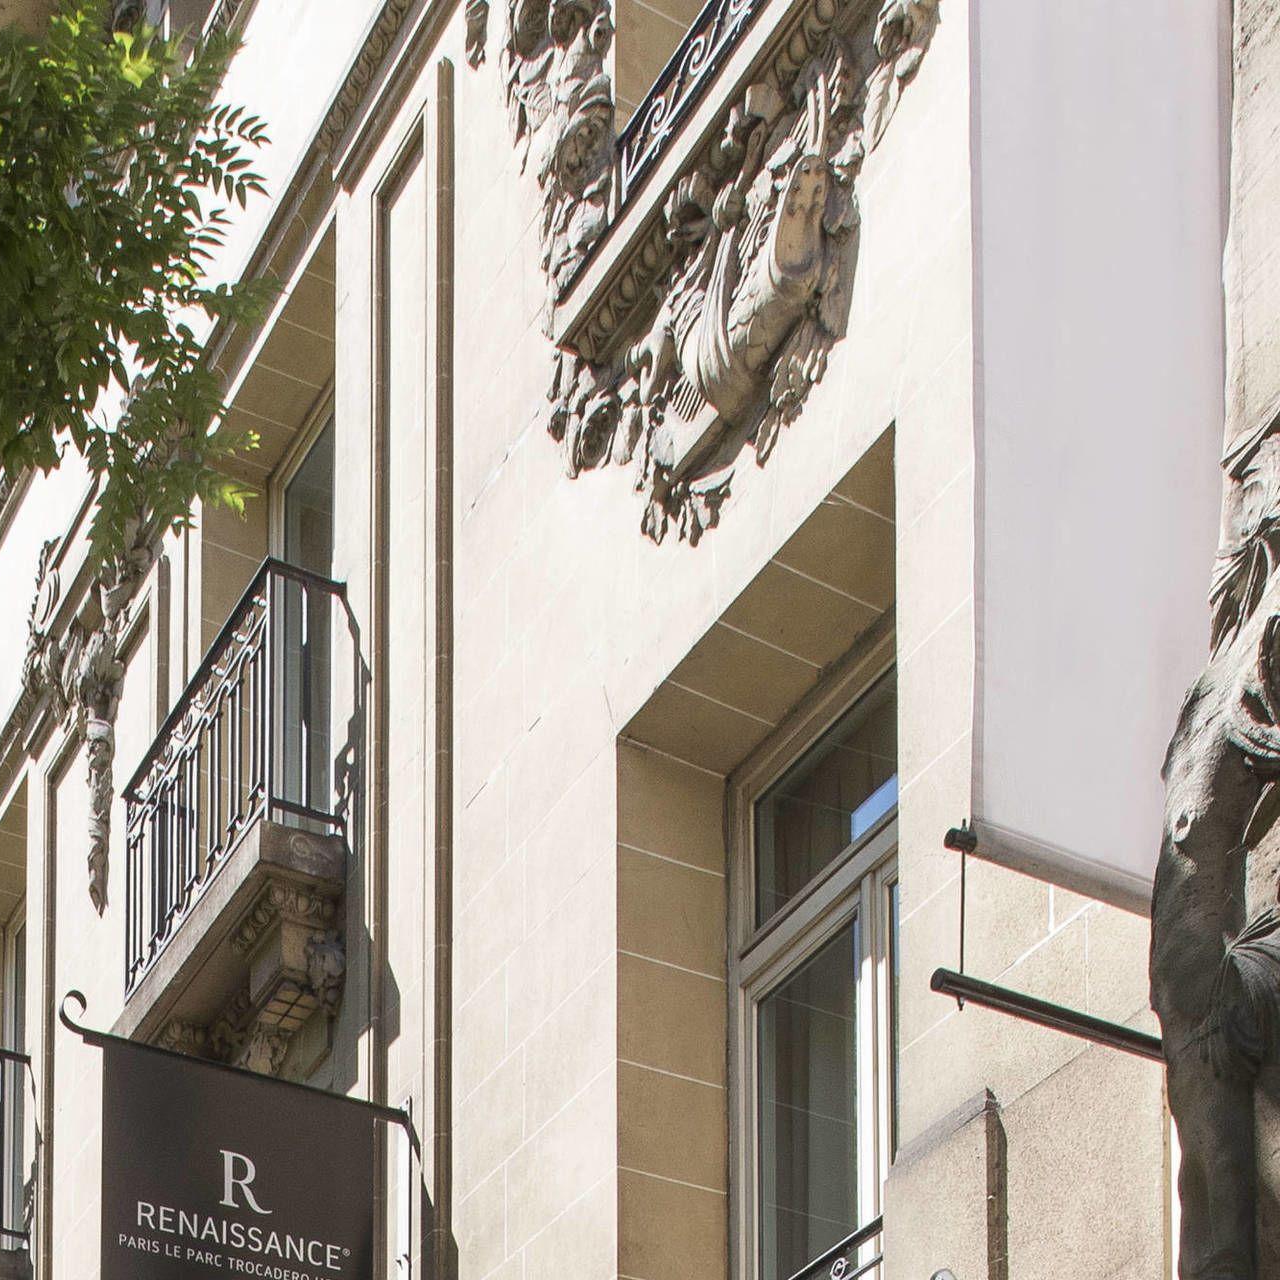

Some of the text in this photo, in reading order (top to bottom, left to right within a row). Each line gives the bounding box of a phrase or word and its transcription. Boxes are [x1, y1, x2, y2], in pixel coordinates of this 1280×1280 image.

[219, 1149, 273, 1215] R
[118, 1233, 160, 1255] PARIS
[165, 1242, 181, 1260] LE
[186, 1247, 223, 1268] PARC
